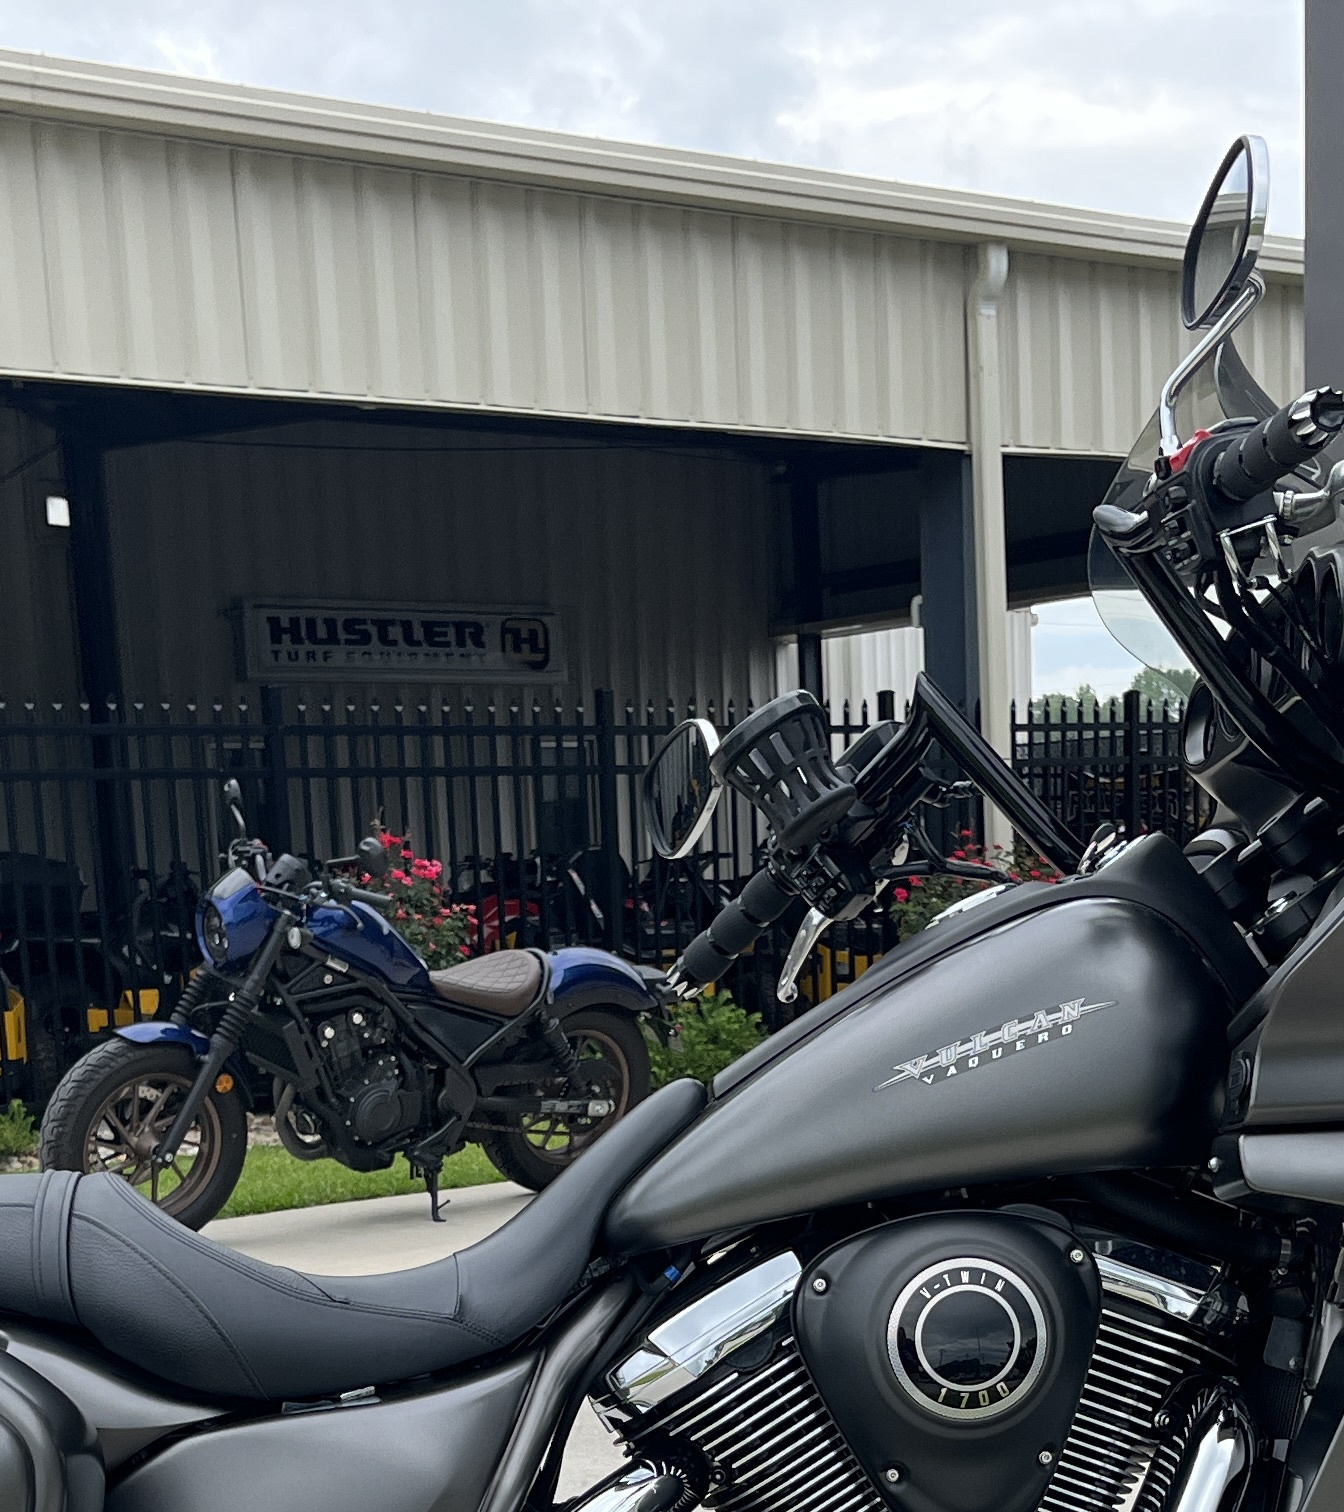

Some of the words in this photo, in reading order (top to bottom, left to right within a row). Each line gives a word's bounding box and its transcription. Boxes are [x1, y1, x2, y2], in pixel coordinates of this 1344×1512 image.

[266, 615, 486, 649] HUSTLER
[271, 649, 333, 663] TURF
[893, 998, 1086, 1079] VULCAN
[922, 1024, 1073, 1085] VAQUERO
[919, 1270, 1006, 1299] V-TWIN
[937, 1381, 1010, 1409] 1700
